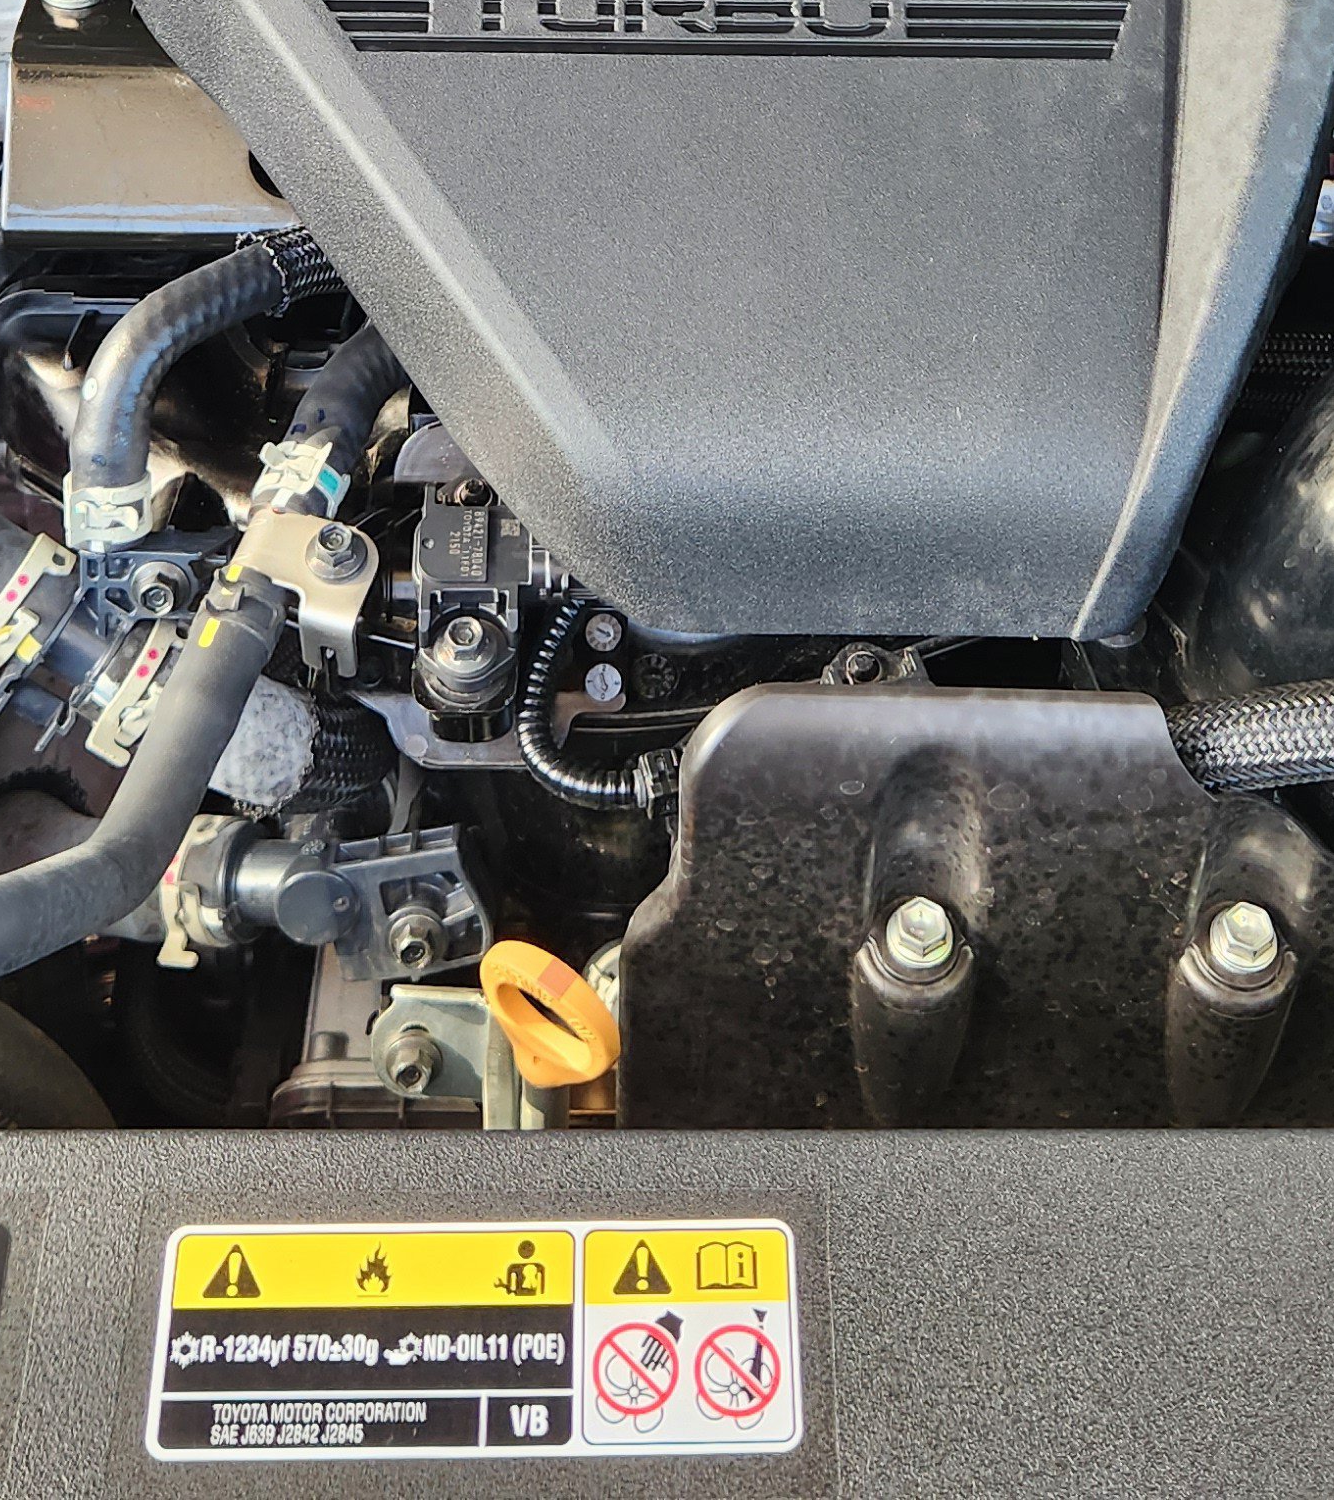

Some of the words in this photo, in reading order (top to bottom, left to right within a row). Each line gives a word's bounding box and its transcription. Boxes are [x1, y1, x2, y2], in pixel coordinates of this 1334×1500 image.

[448, 531, 461, 555] 2150
[462, 508, 473, 544] TOYOTA
[199, 1333, 291, 1368] R-1234yf
[292, 1333, 380, 1367] 570±30g
[423, 1333, 509, 1362] ND-OIL11
[512, 1332, 566, 1366] (POE)
[212, 1402, 269, 1425] TOYOTA
[270, 1402, 324, 1424] MOTOR
[325, 1401, 428, 1424] CORPORATION
[509, 1403, 550, 1438] VB
[209, 1424, 239, 1446] SAE
[240, 1423, 276, 1445] J639
[276, 1423, 320, 1445] J2842
[320, 1423, 365, 1445] J2845
